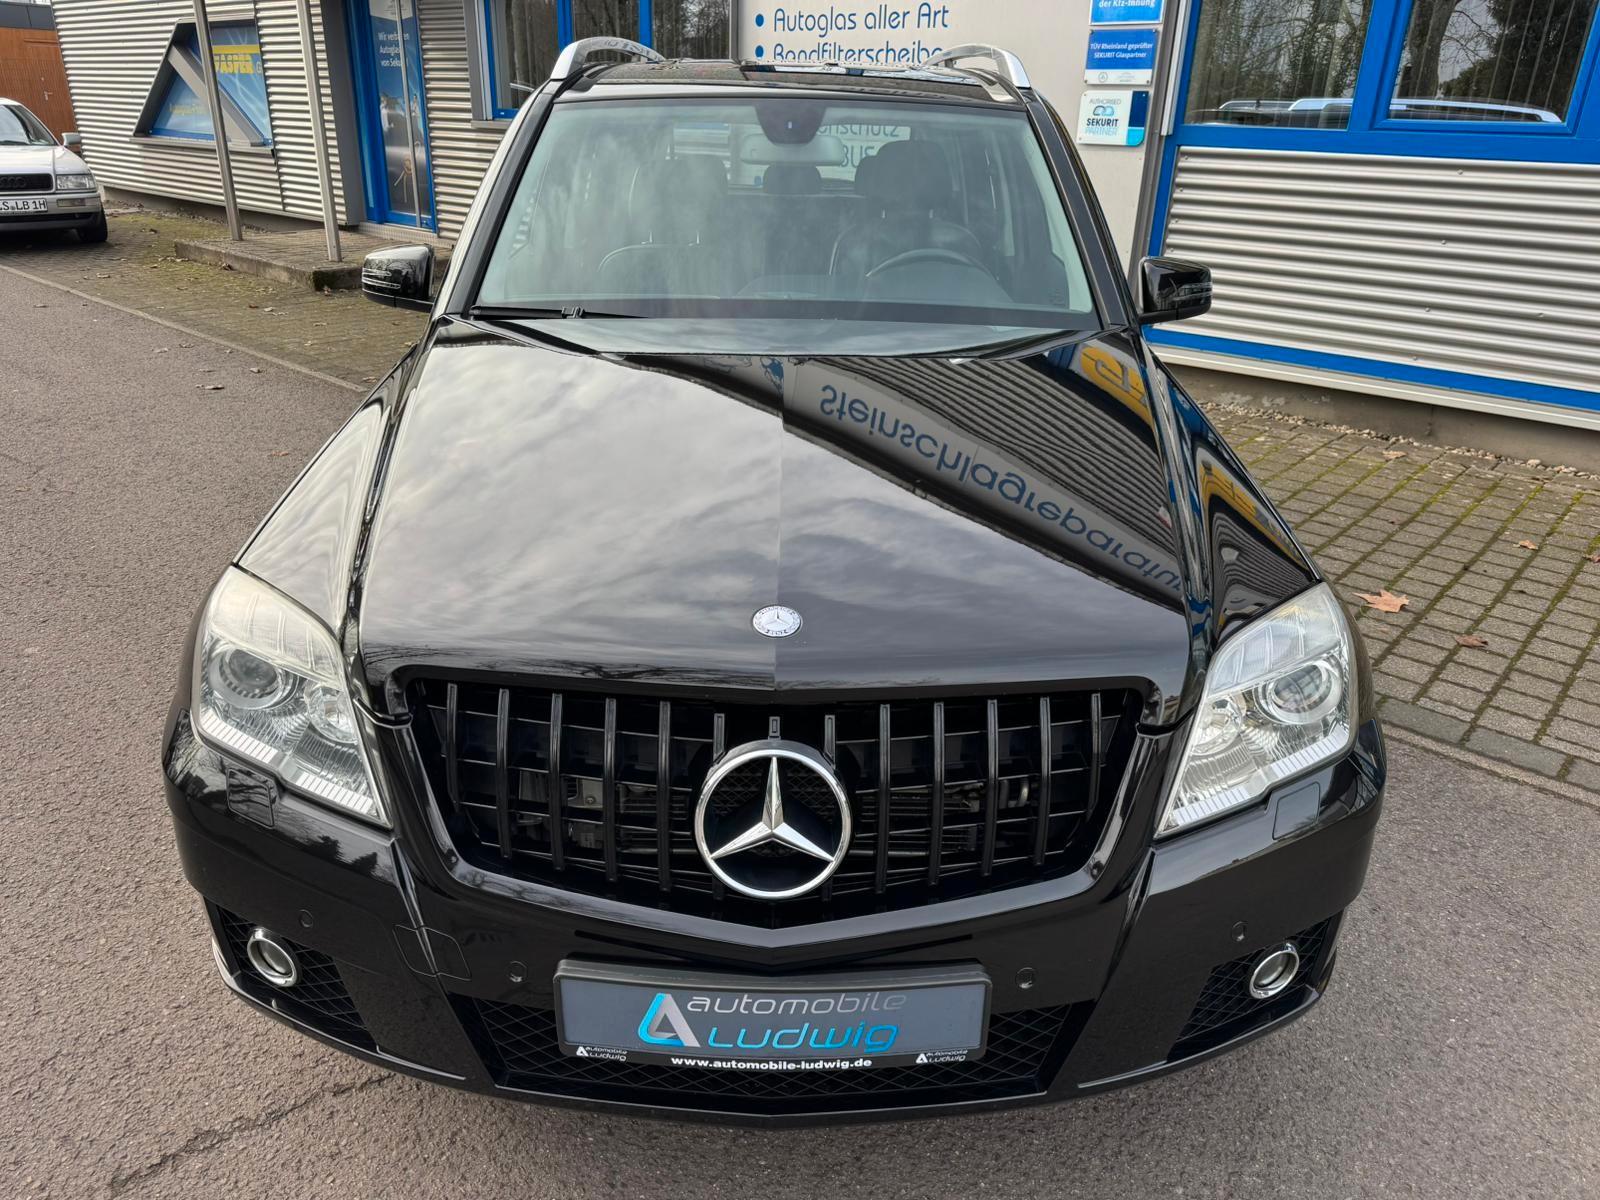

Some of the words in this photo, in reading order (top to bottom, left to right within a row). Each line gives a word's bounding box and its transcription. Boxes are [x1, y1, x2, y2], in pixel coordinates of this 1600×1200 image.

[774, 6, 857, 38] Autoglas
[864, 4, 911, 30] aller
[917, 2, 949, 29] Art
[1090, 42, 1101, 50] TÜV
[1101, 42, 1128, 50] Rheinland
[1115, 51, 1147, 60] Glaspartner
[1086, 118, 1119, 127] SEKURIT
[15, 200, 30, 210] LB
[687, 991, 907, 1015] automobile
[707, 1020, 899, 1053] Ludwig
[670, 1056, 873, 1071] www.automobile-ludwig.de
